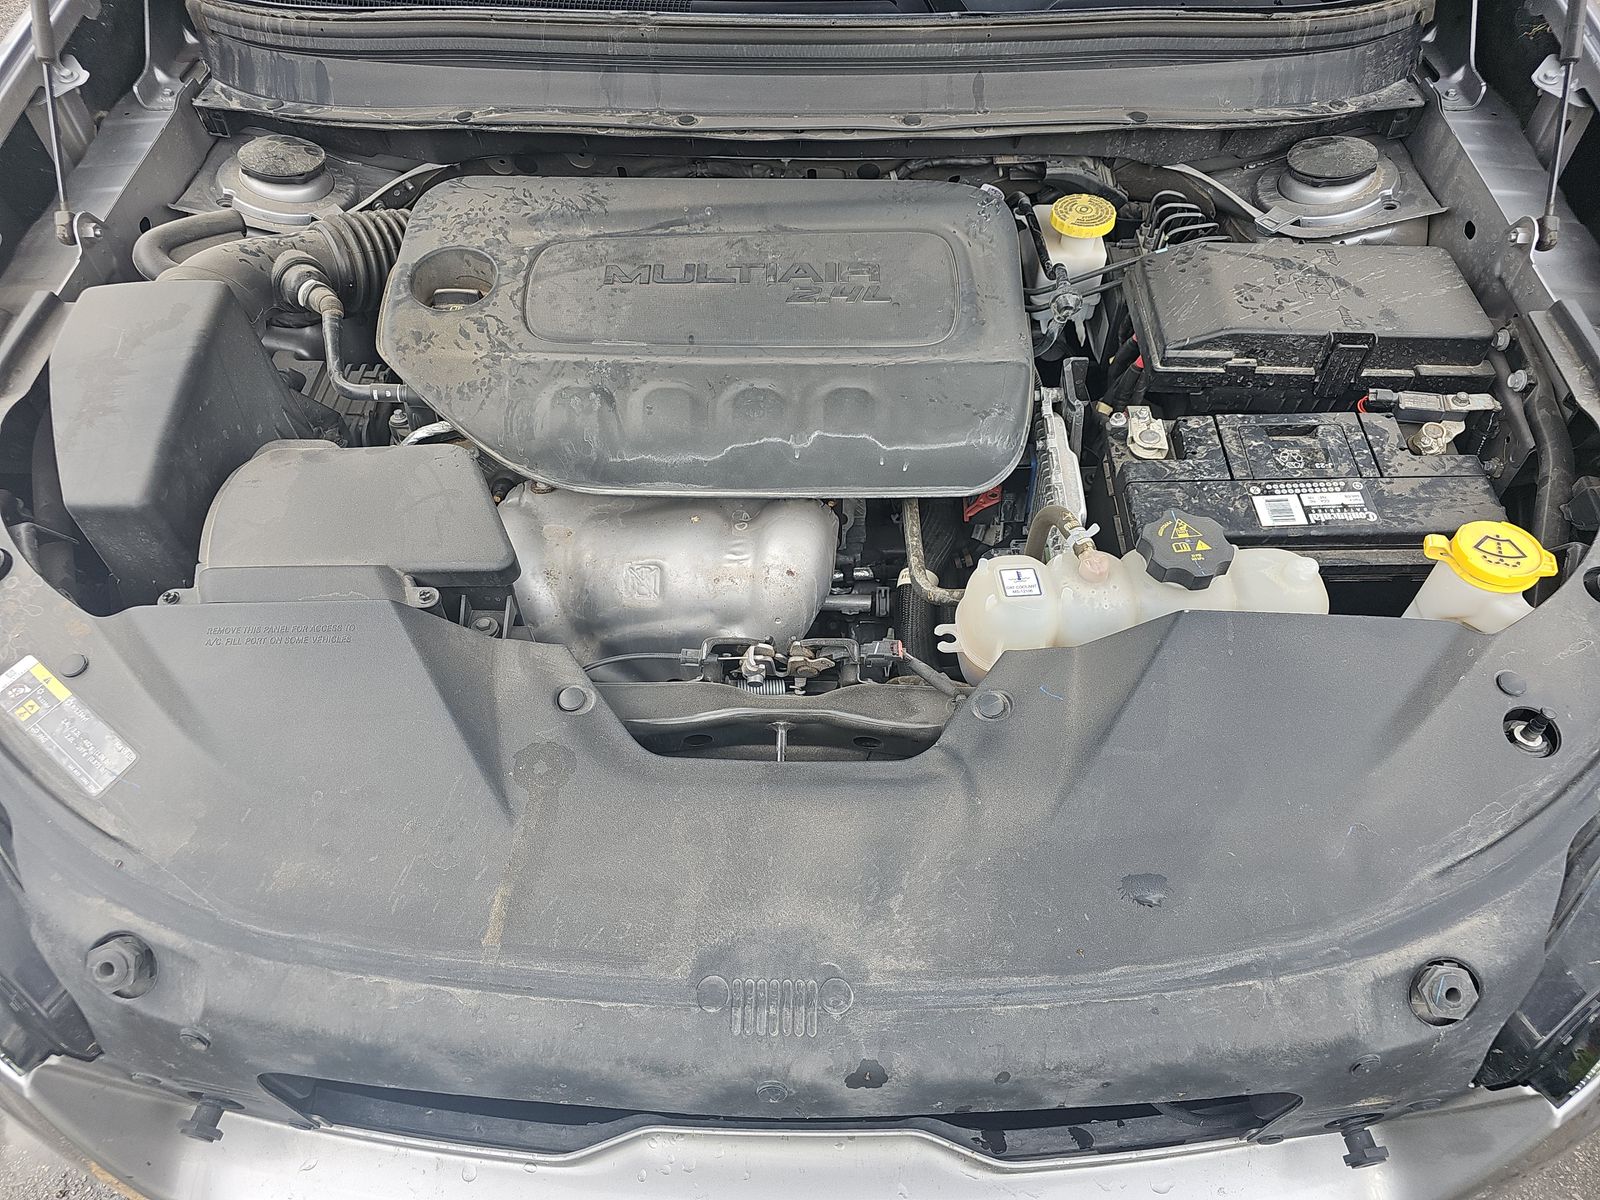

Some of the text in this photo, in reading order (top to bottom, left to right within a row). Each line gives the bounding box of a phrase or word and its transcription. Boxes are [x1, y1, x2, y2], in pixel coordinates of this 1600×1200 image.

[602, 262, 882, 285] MULTIAIR
[785, 285, 892, 304] 2.4L
[206, 623, 356, 635] REMOVE THIS PANEL FOR ACCESS TO
[205, 635, 352, 647] A/C FILL PORT ON SOME VEHICLES
